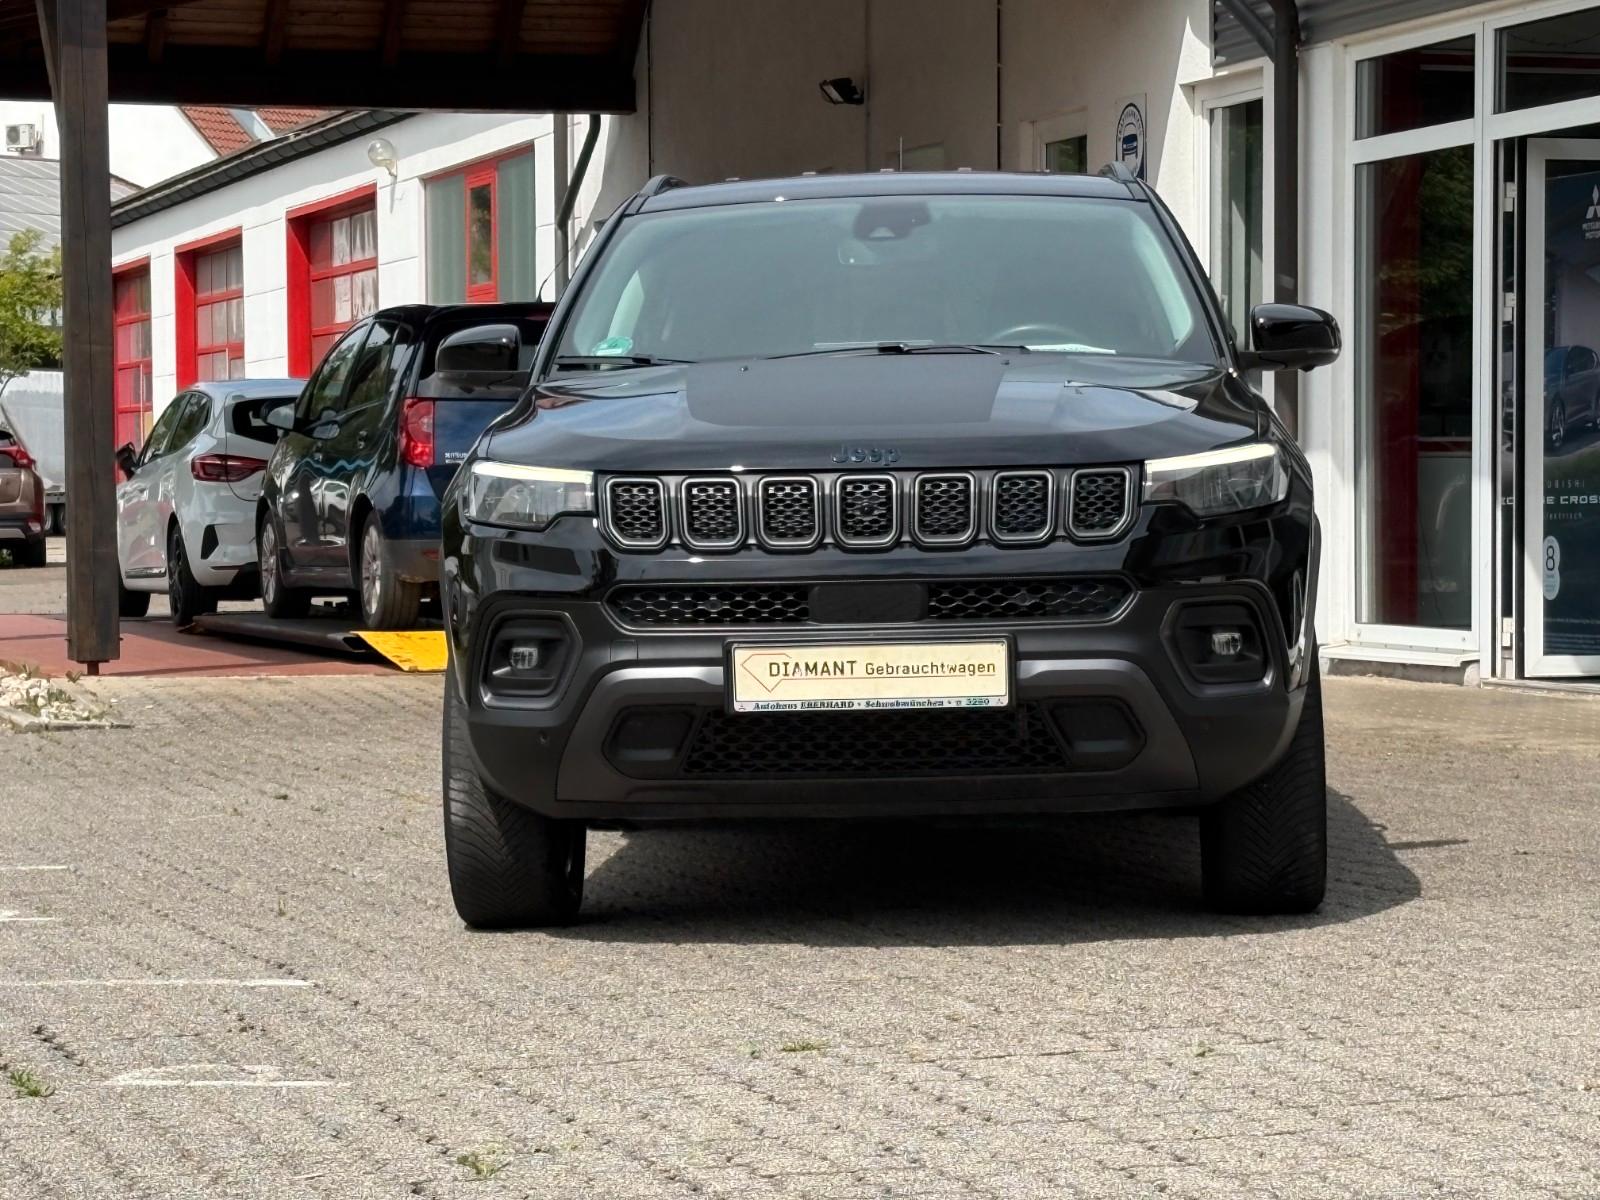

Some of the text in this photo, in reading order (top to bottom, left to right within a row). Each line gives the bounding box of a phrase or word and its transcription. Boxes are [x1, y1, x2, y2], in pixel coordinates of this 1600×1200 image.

[831, 444, 899, 466] Jeep
[1560, 495, 1600, 505] CROS
[1546, 545, 1555, 571] 8
[769, 660, 996, 677] DIAMANT Gebrauchtwagen
[753, 702, 798, 711] Autohaus
[800, 701, 855, 710] EBERHARD
